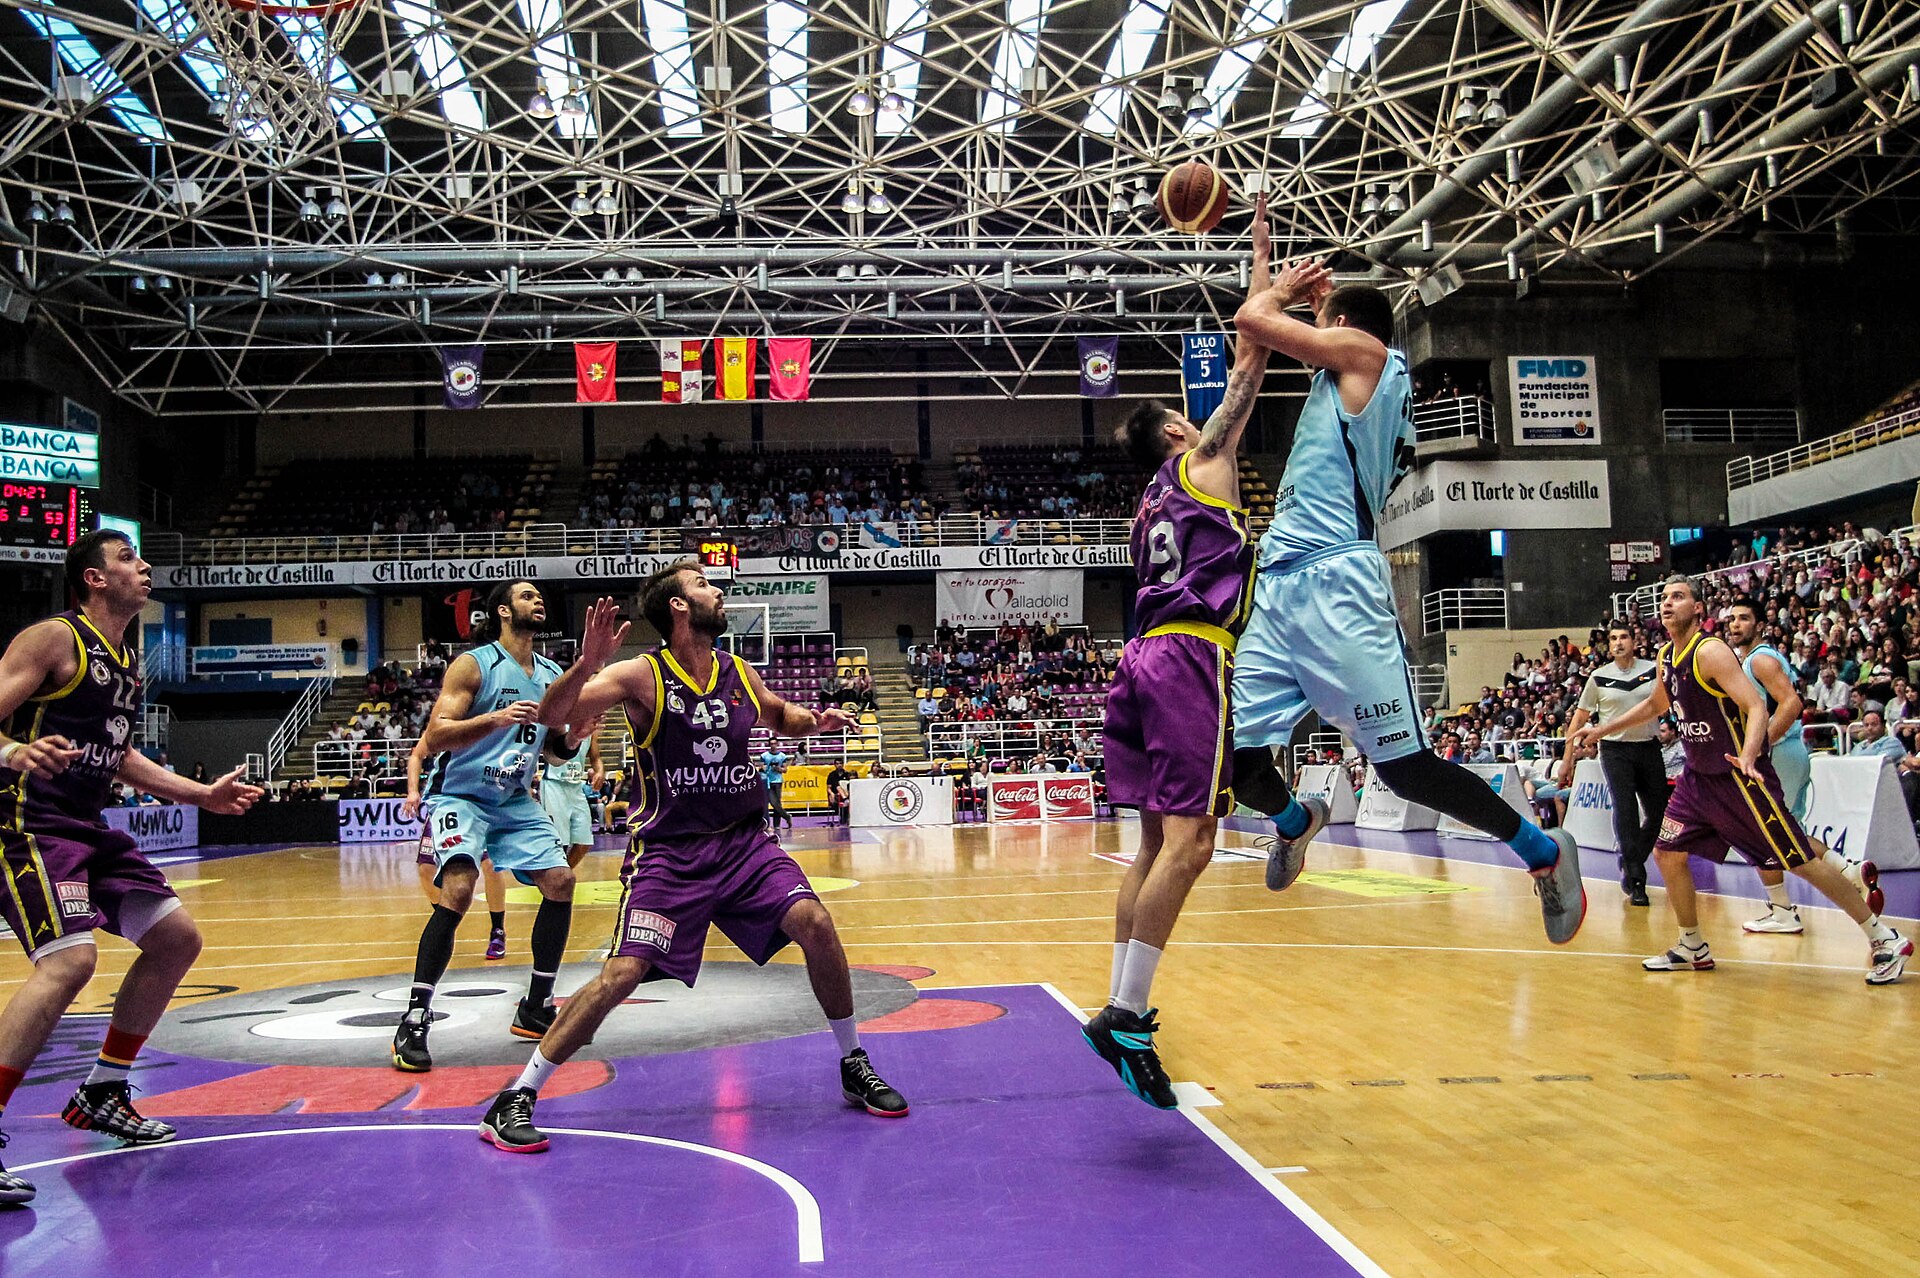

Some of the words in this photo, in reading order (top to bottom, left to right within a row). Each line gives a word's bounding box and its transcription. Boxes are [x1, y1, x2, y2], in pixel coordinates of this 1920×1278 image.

[1190, 337, 1216, 349] LALO
[1200, 360, 1211, 378] 5
[1517, 360, 1587, 378] FMD
[1518, 382, 1589, 391] Fundación
[1519, 391, 1589, 400] Municipal
[1520, 401, 1537, 409] de
[1520, 410, 1592, 419] Deportes
[0, 427, 81, 454] BANCA
[0, 455, 83, 481] BANCA
[3, 483, 47, 499] 04:27
[1411, 484, 1434, 511] Castilla
[1446, 481, 1466, 501] El
[1472, 481, 1515, 501] Norte
[1518, 482, 1535, 500] de
[1539, 480, 1600, 500] Castilla
[44, 511, 65, 525] 53
[50, 528, 60, 539] 2
[34, 551, 47, 560] de
[48, 552, 66, 561] Vall
[709, 552, 726, 566] 16
[853, 552, 871, 569] de
[873, 550, 942, 569] Castilla
[979, 547, 1001, 566] El
[1003, 547, 1050, 566] Norte
[1051, 547, 1070, 565] de
[1072, 545, 1132, 566] Castill
[1148, 521, 1181, 583] 9
[169, 566, 192, 586] El
[195, 566, 243, 585] Norte
[245, 567, 263, 585] de
[265, 564, 335, 584] Castilla
[372, 562, 395, 582] El
[399, 561, 445, 581] Norte
[449, 562, 466, 580] de
[469, 560, 539, 579] Castilla
[575, 557, 599, 577] El
[601, 556, 649, 576] Norte
[951, 580, 962, 588] en
[965, 577, 974, 586] tu
[951, 611, 1069, 621] info.valladolid.es
[113, 672, 136, 711] 22
[1670, 673, 1679, 697] 8
[692, 698, 730, 730] 43
[1353, 698, 1403, 721] ÉLIDE
[515, 723, 538, 745] 16
[784, 776, 819, 789] rovial
[438, 811, 459, 835] 16
[632, 911, 673, 934] BRICO
